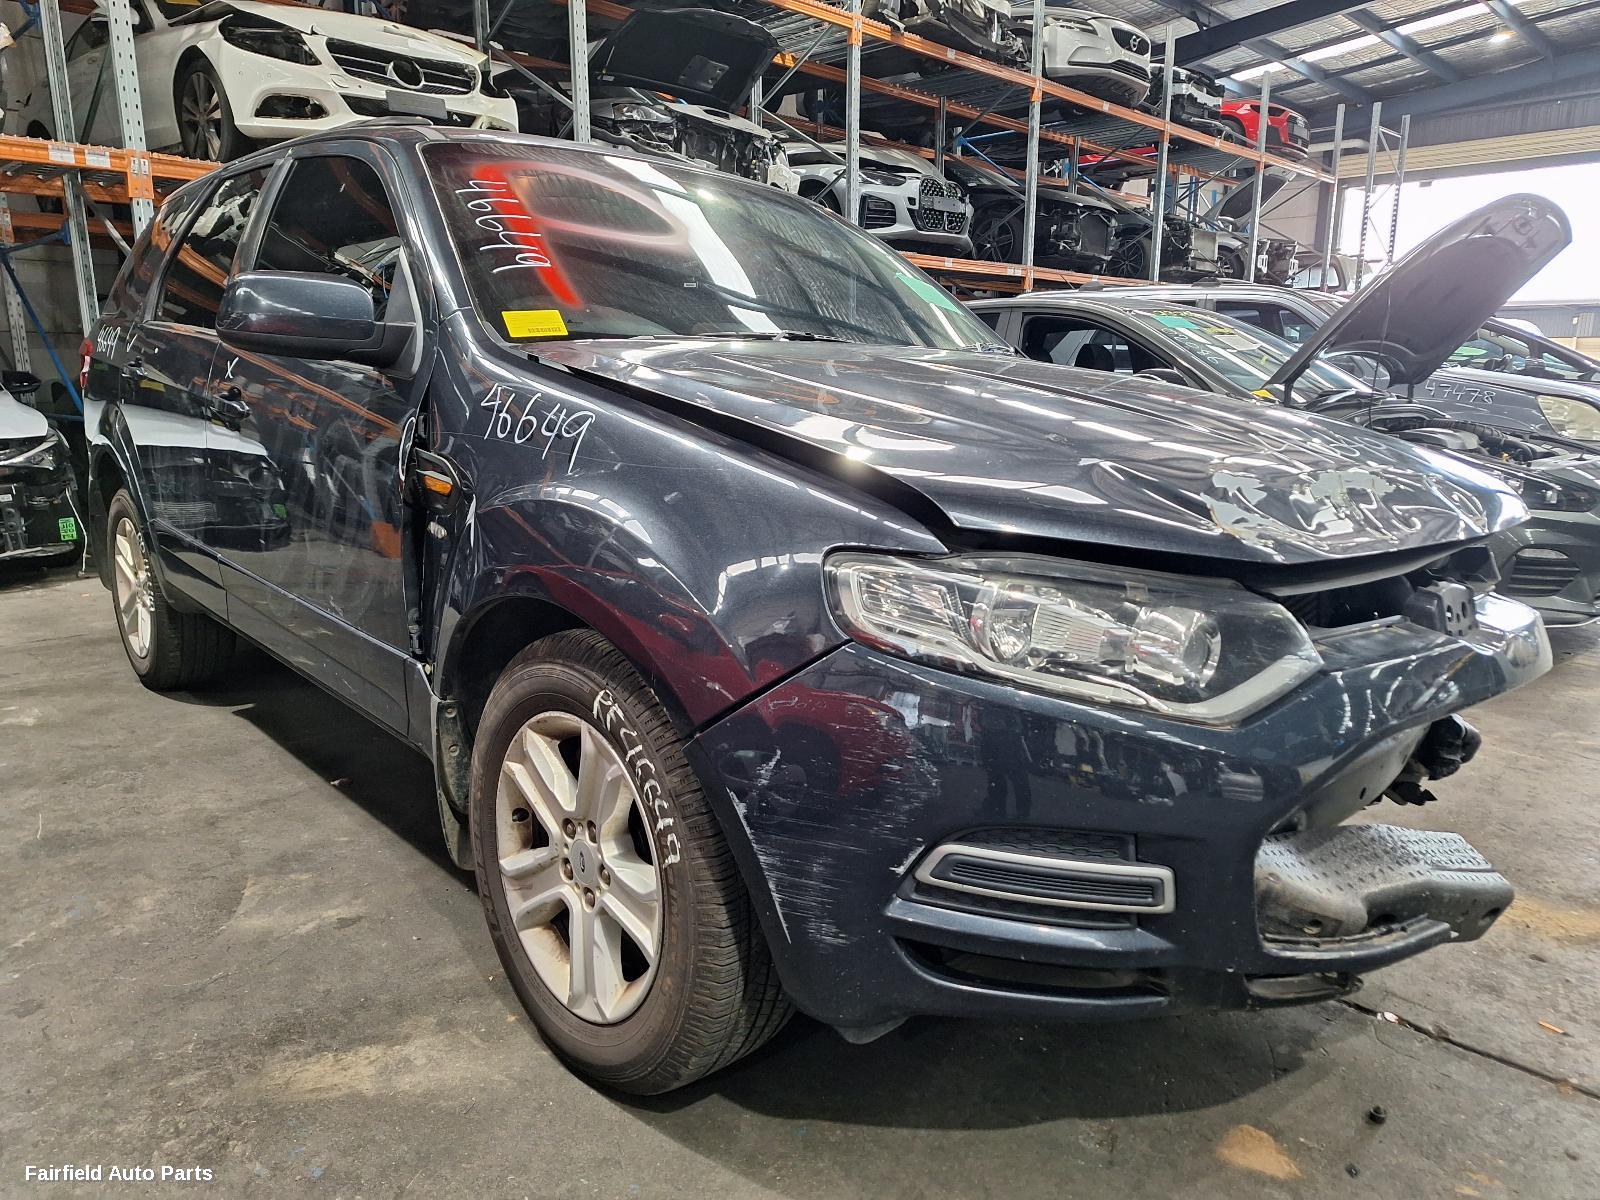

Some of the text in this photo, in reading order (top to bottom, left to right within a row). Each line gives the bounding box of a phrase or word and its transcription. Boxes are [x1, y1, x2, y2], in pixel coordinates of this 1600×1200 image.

[454, 180, 552, 273] 46649
[480, 382, 596, 475] 46649
[1424, 379, 1496, 404] 47478
